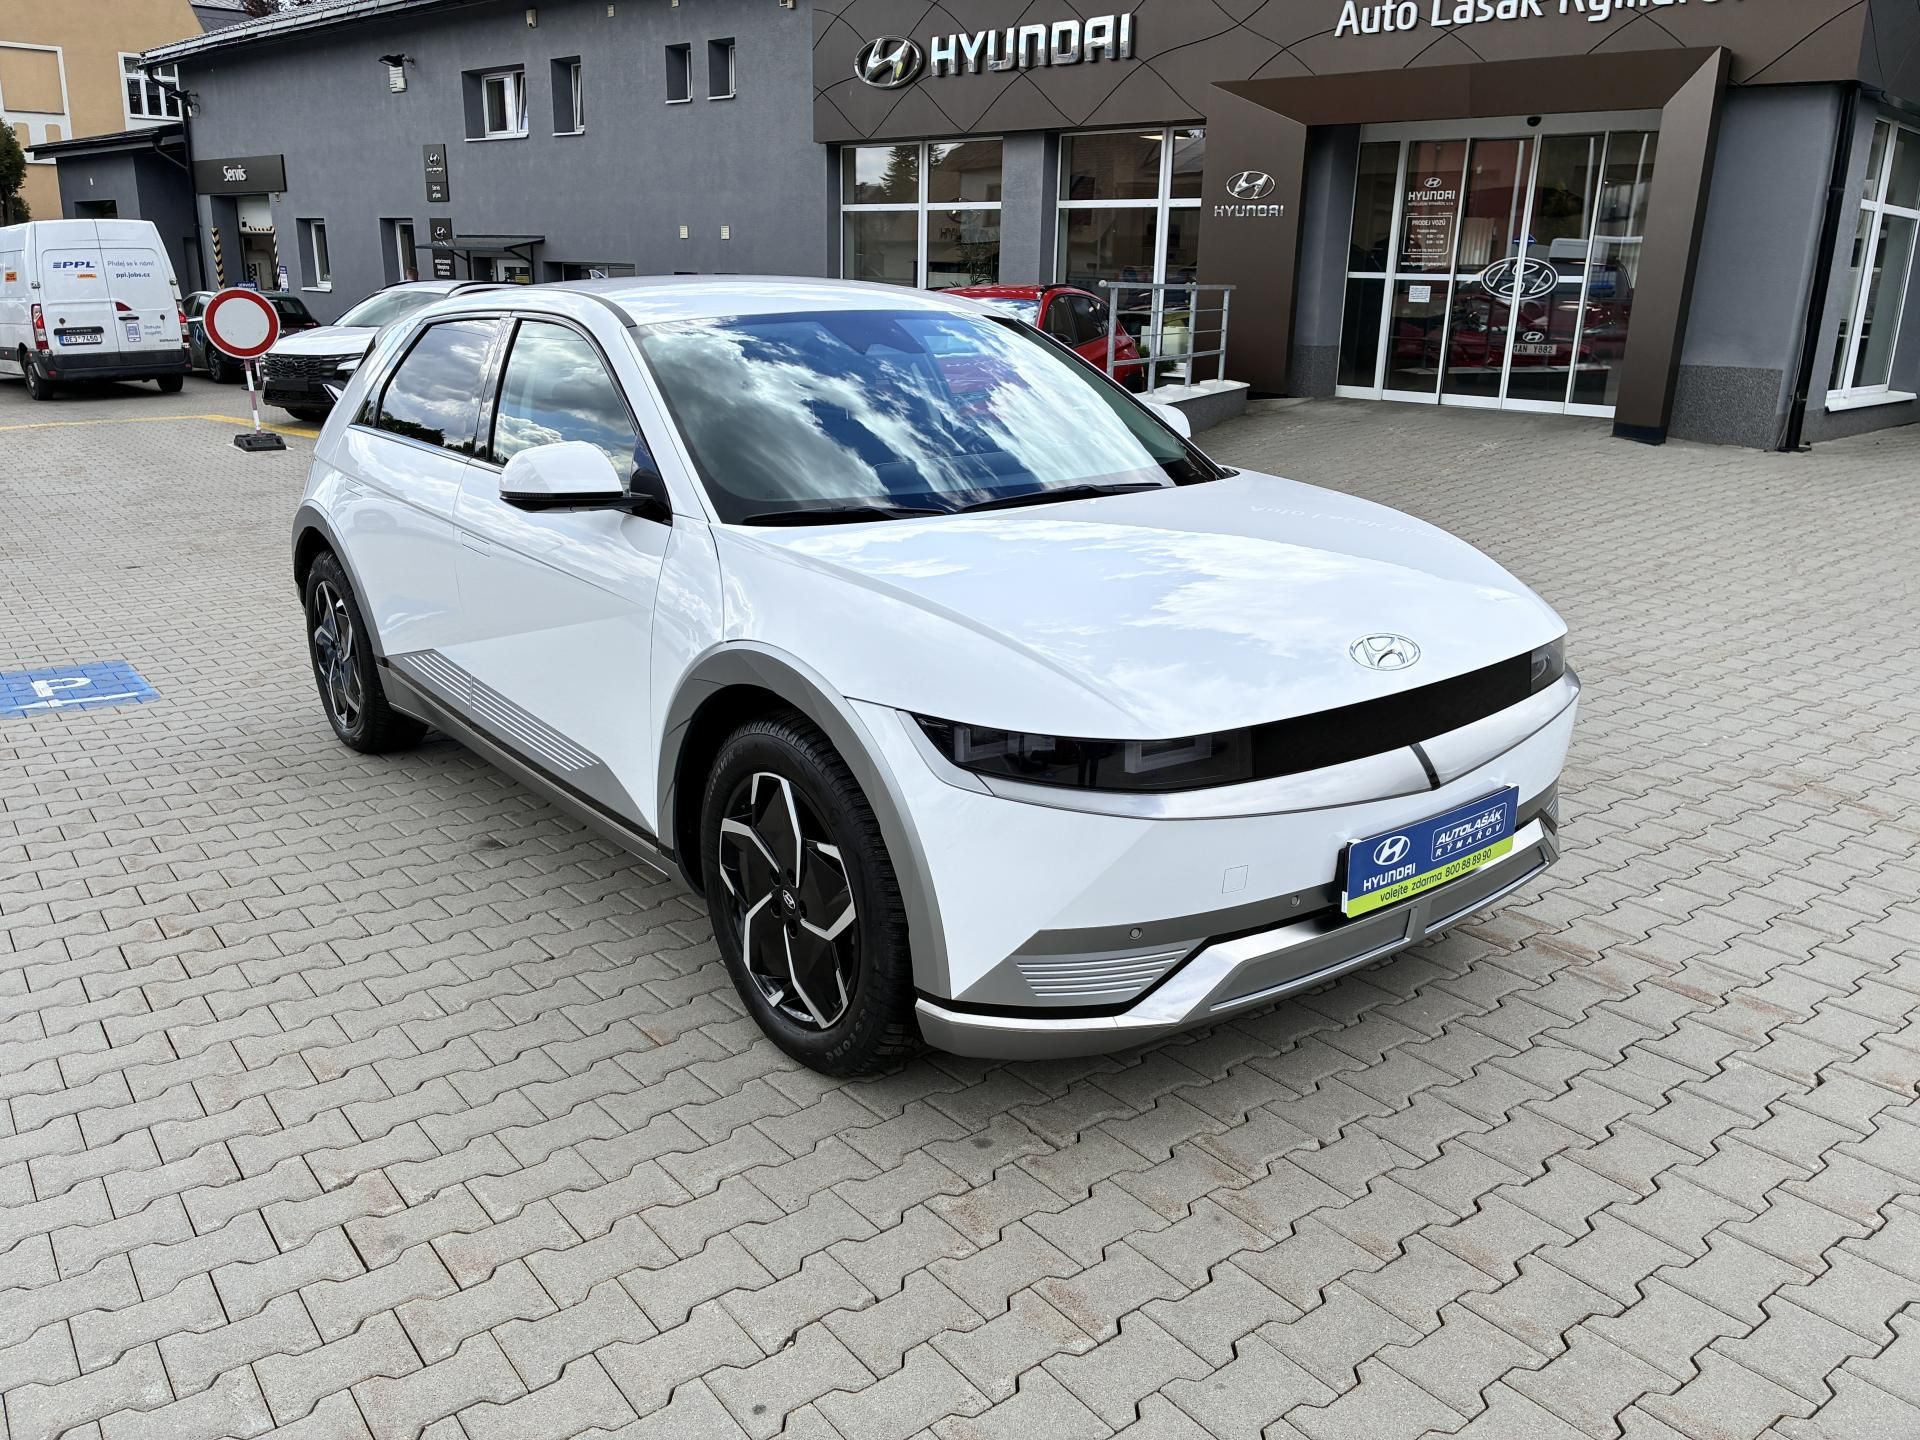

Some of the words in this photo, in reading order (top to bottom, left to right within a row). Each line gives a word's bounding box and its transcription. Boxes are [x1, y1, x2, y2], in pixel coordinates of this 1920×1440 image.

[1334, 0, 1418, 37] Auto
[931, 13, 1132, 76] HYUNDAI
[223, 165, 247, 181] Servis
[1408, 190, 1456, 200] HYUNDAI
[1214, 205, 1284, 217] HYUNDAI
[62, 261, 96, 269] PPL
[115, 271, 151, 279] ppl.jobs.cz
[1436, 809, 1503, 845] AUTOLAŠÁK
[1364, 863, 1416, 892] HYUNDAI
[1380, 886, 1408, 902] volejte
[1411, 871, 1442, 891] zdarma
[1445, 862, 1460, 877] 800
[1461, 858, 1471, 871] 88
[1472, 853, 1481, 867] 89
[1482, 848, 1492, 862] 90
